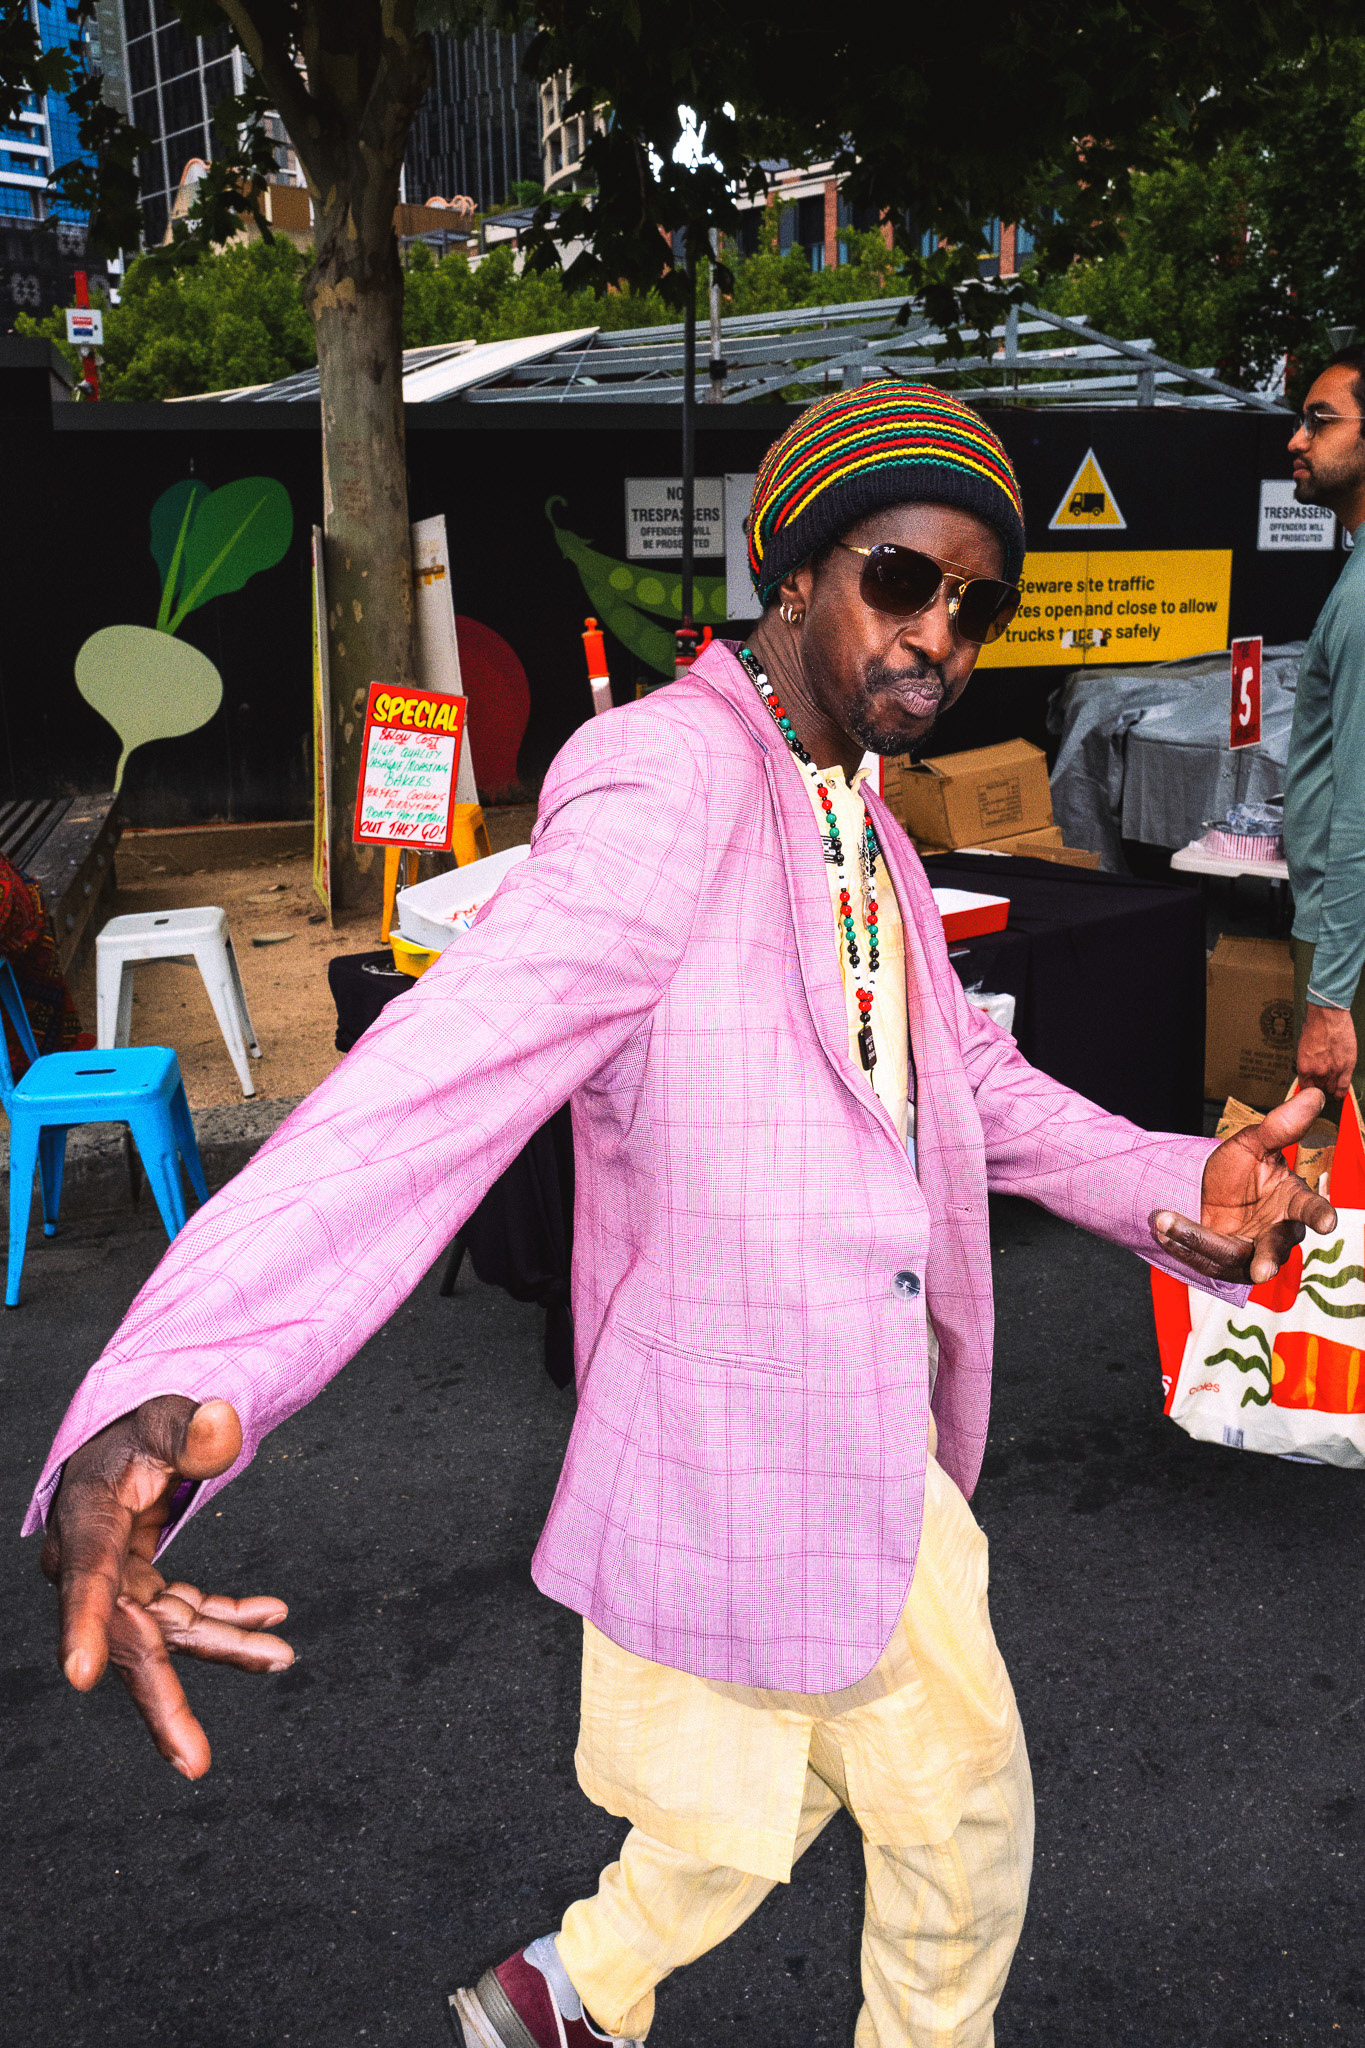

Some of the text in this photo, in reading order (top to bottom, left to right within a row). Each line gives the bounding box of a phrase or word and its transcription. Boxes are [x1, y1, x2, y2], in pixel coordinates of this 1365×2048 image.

[631, 508, 720, 522] TRESPAERS
[1264, 506, 1333, 519] TRESPASSERS
[640, 526, 684, 537] OFFENDER
[1269, 523, 1325, 531] OFFENDERS WILL
[643, 539, 710, 549] BE PROSETED
[1270, 534, 1323, 542] BE PROSECUTED
[1077, 578, 1104, 593] ste
[1108, 575, 1155, 591] traffic
[1045, 604, 1082, 621] open
[1085, 600, 1113, 616] and
[1117, 600, 1157, 615] close
[1161, 600, 1175, 614] to
[1179, 598, 1218, 614] allow
[1006, 626, 1055, 643] trucks
[1079, 627, 1112, 642] pas
[1116, 623, 1161, 641] safely
[372, 692, 459, 732] SPECIAL
[379, 728, 445, 748] BELOW COST
[370, 742, 443, 760] HIGH QUALITY
[384, 771, 431, 788] BAKERS
[364, 785, 447, 802] PERFECT COOKING
[396, 810, 415, 823] PAY
[415, 812, 446, 824] RETAIL
[360, 820, 447, 840] OUT THEY GO!
